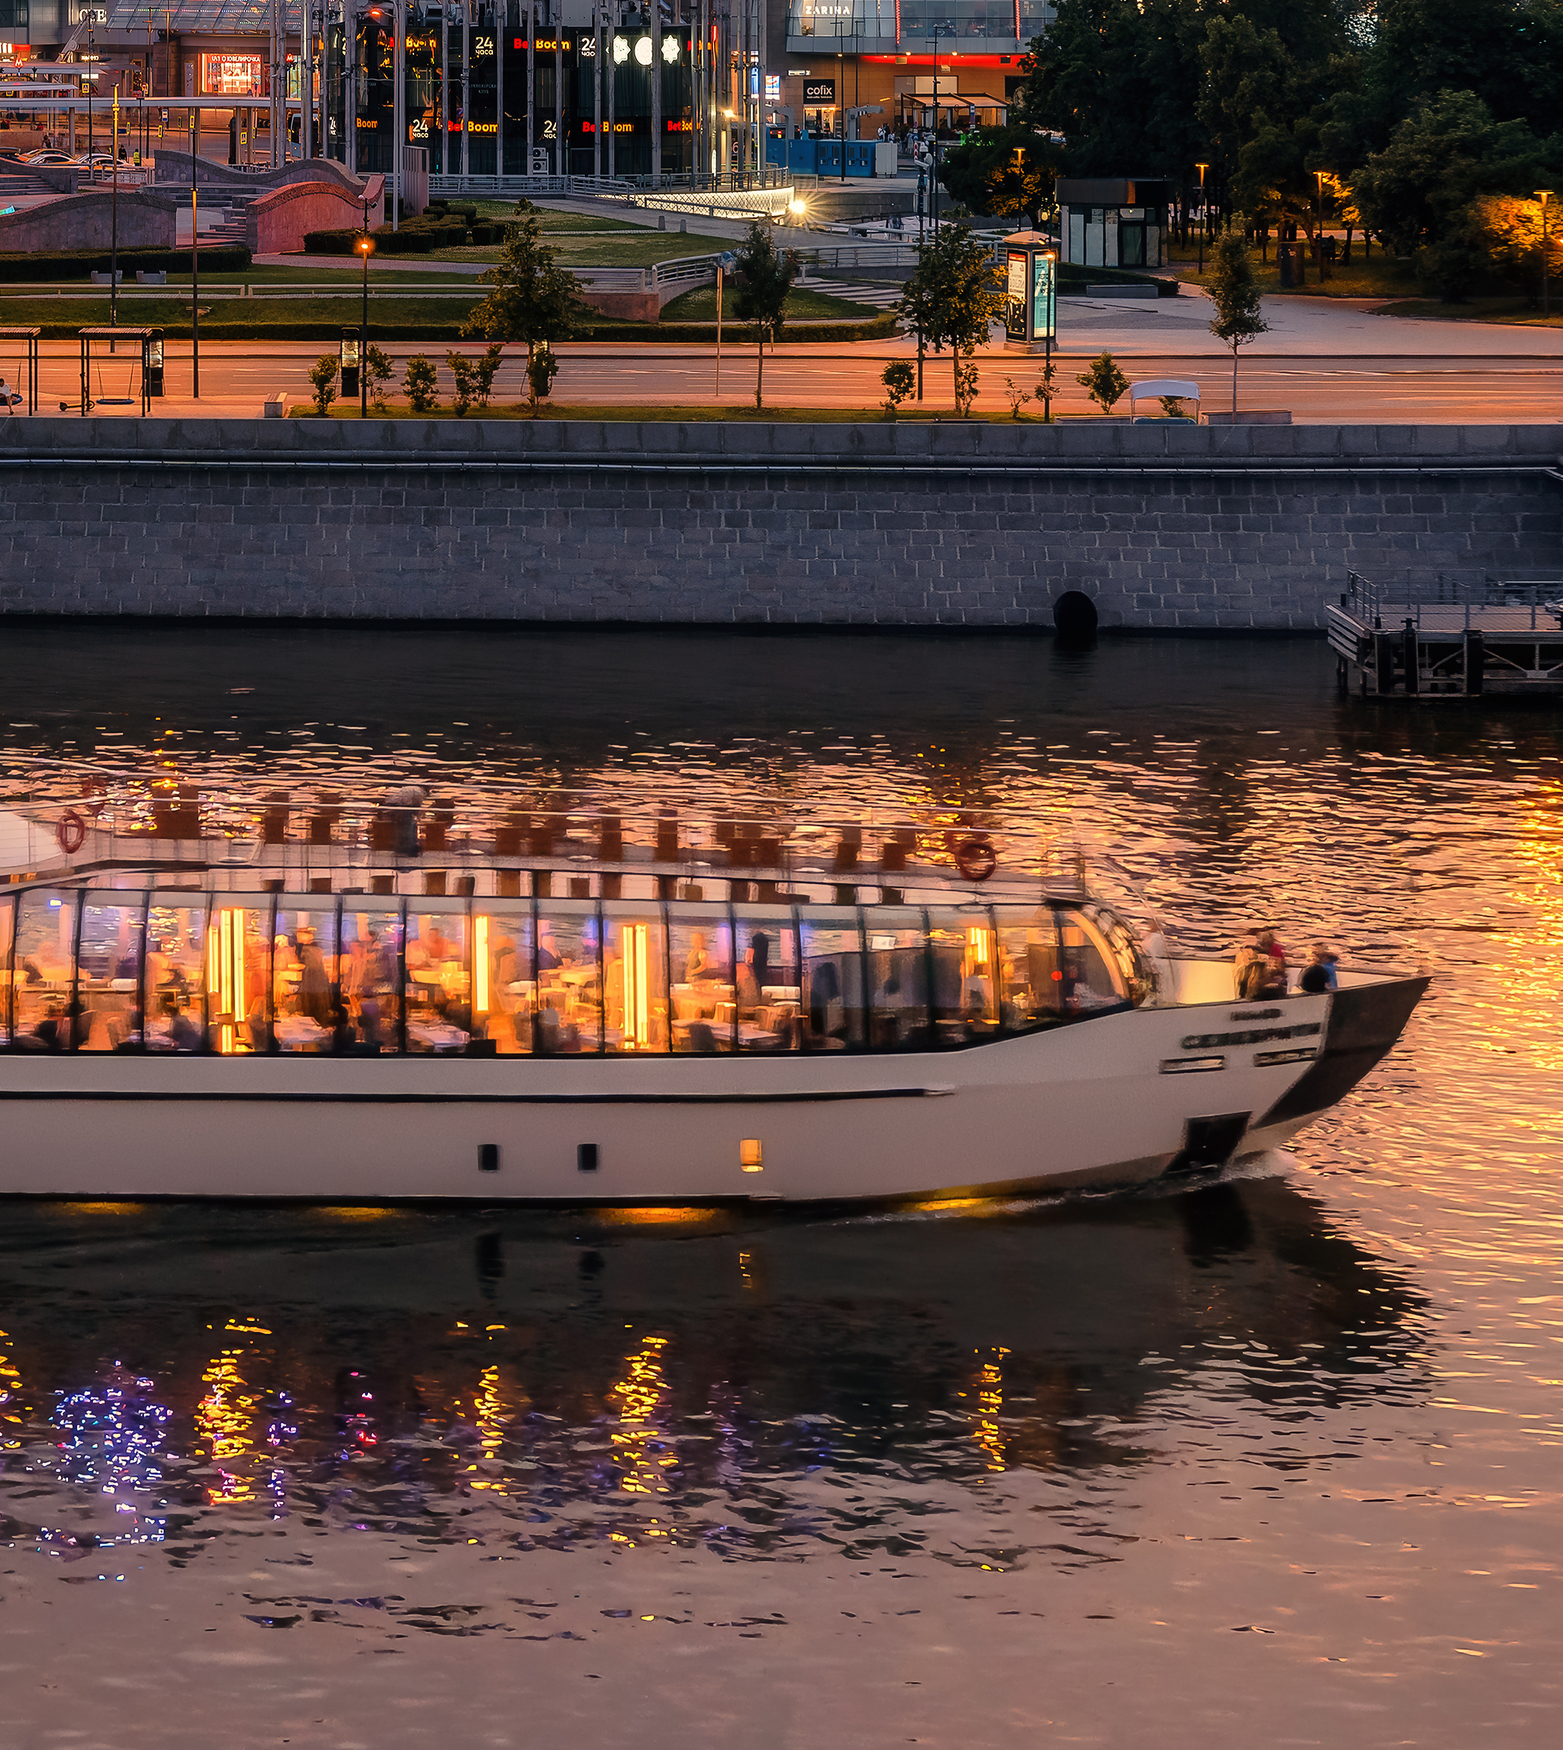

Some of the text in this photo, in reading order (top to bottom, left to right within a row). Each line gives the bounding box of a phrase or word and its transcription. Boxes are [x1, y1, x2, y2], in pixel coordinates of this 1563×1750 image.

[475, 36, 494, 49] 24
[513, 37, 570, 50] BeBoom
[806, 84, 833, 96] cofix
[412, 119, 429, 133] 24
